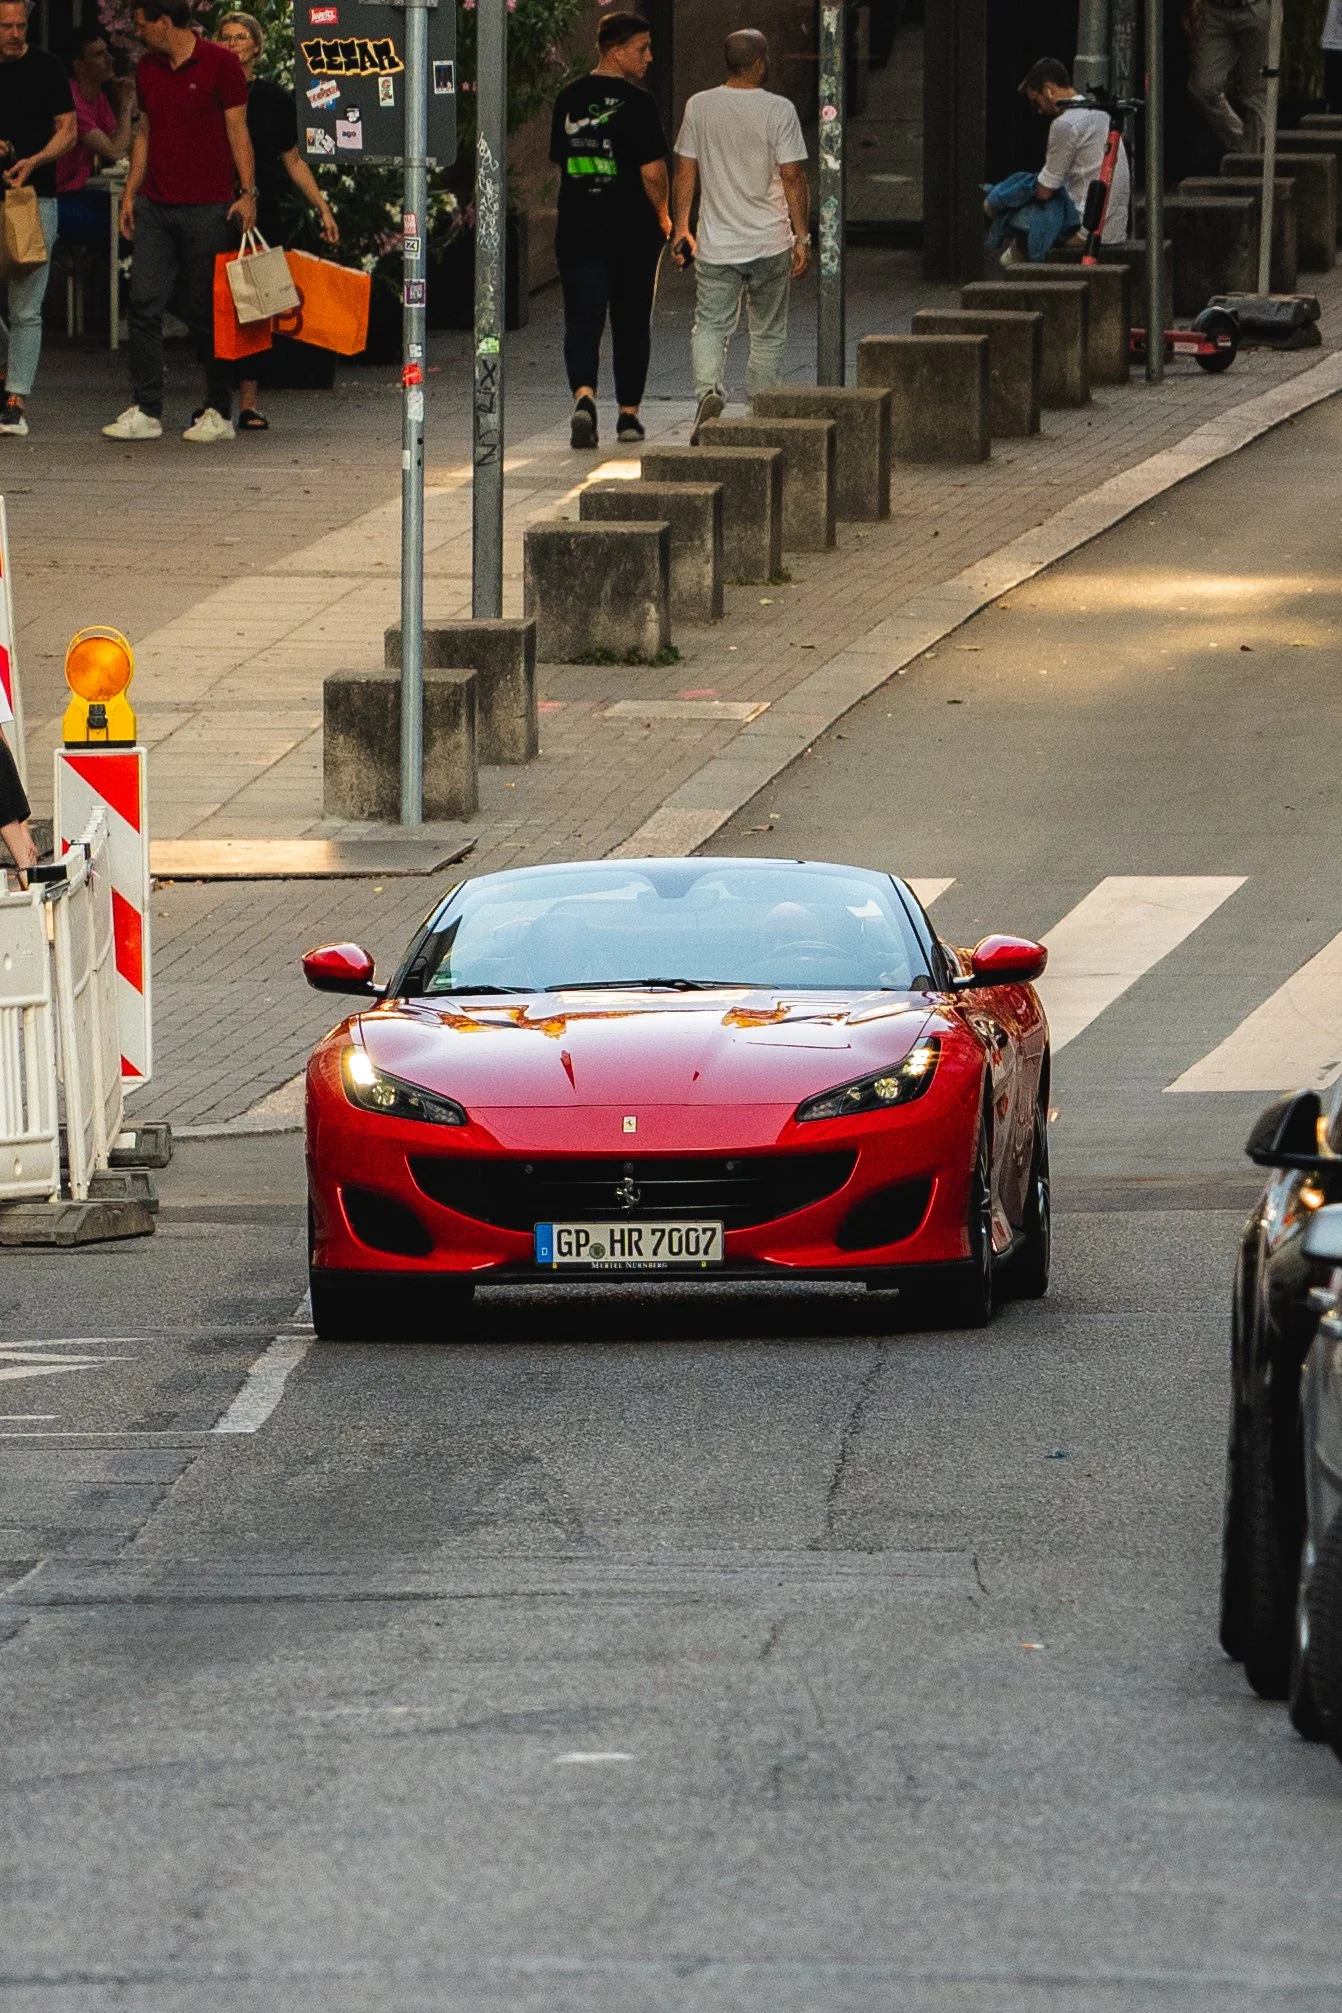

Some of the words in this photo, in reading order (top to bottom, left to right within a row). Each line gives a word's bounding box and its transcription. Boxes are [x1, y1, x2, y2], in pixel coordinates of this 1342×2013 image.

[342, 130, 357, 139] ago
[541, 1247, 548, 1256] D
[556, 1228, 590, 1257] GP
[609, 1228, 644, 1257] HR
[651, 1227, 717, 1257] 7007
